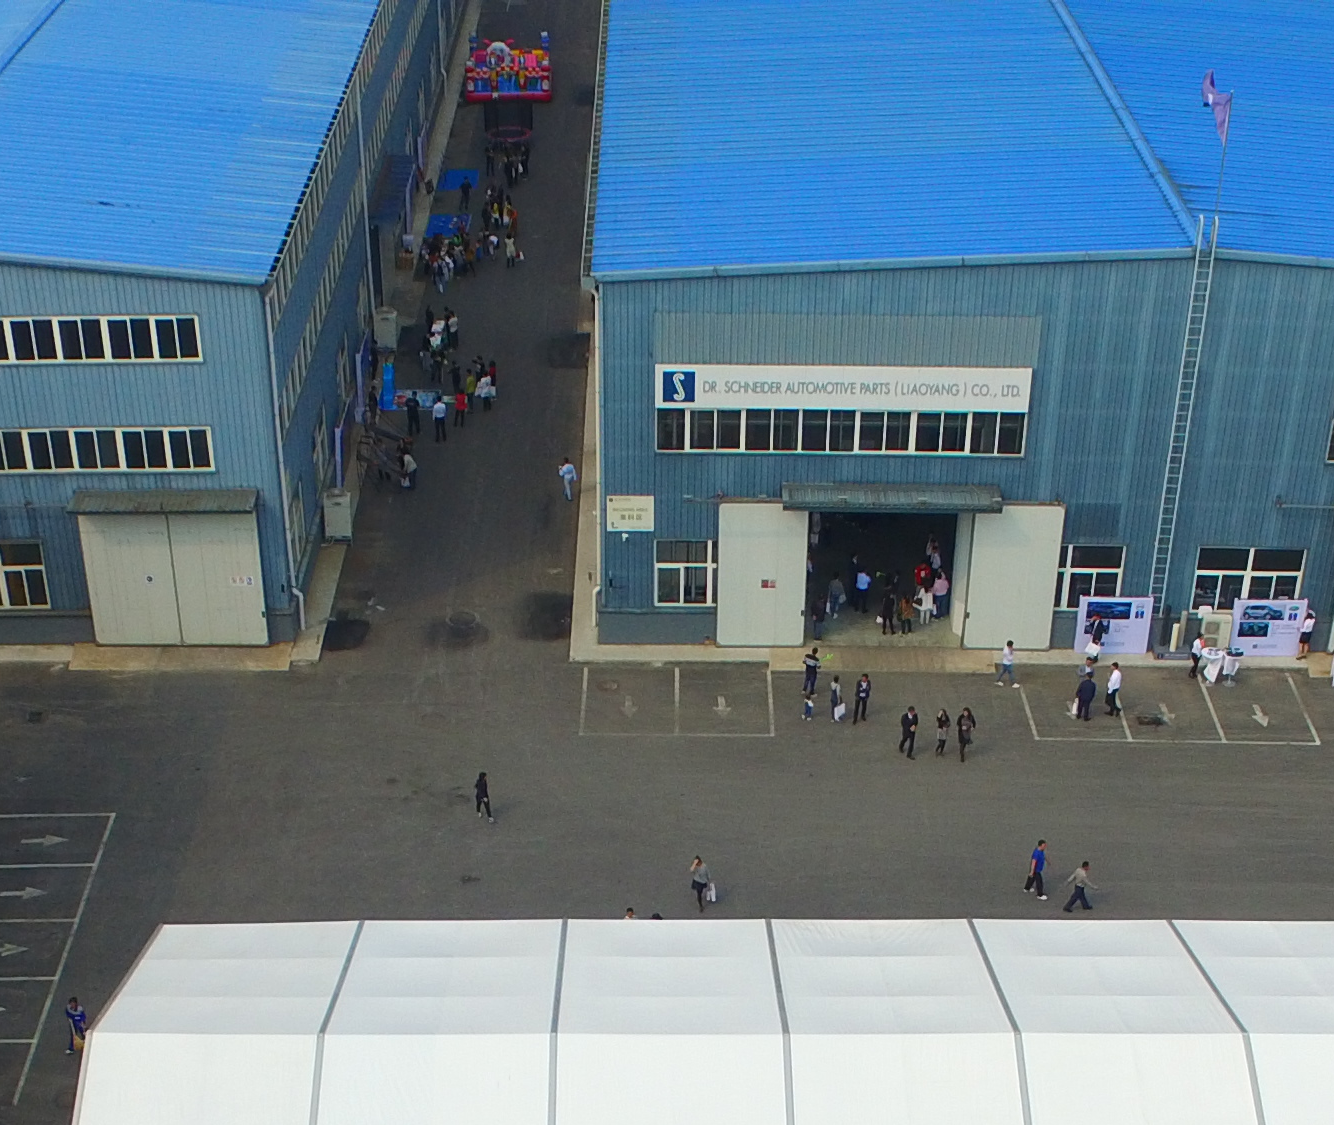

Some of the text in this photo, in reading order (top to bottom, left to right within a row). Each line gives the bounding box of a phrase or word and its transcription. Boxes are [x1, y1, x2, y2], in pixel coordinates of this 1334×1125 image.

[703, 381, 721, 393] DR.
[724, 381, 783, 394] SCHNEIDER
[785, 382, 856, 395] AUTOMOTIVE
[860, 382, 890, 395] PARTS
[1001, 385, 1020, 397] LTD.
